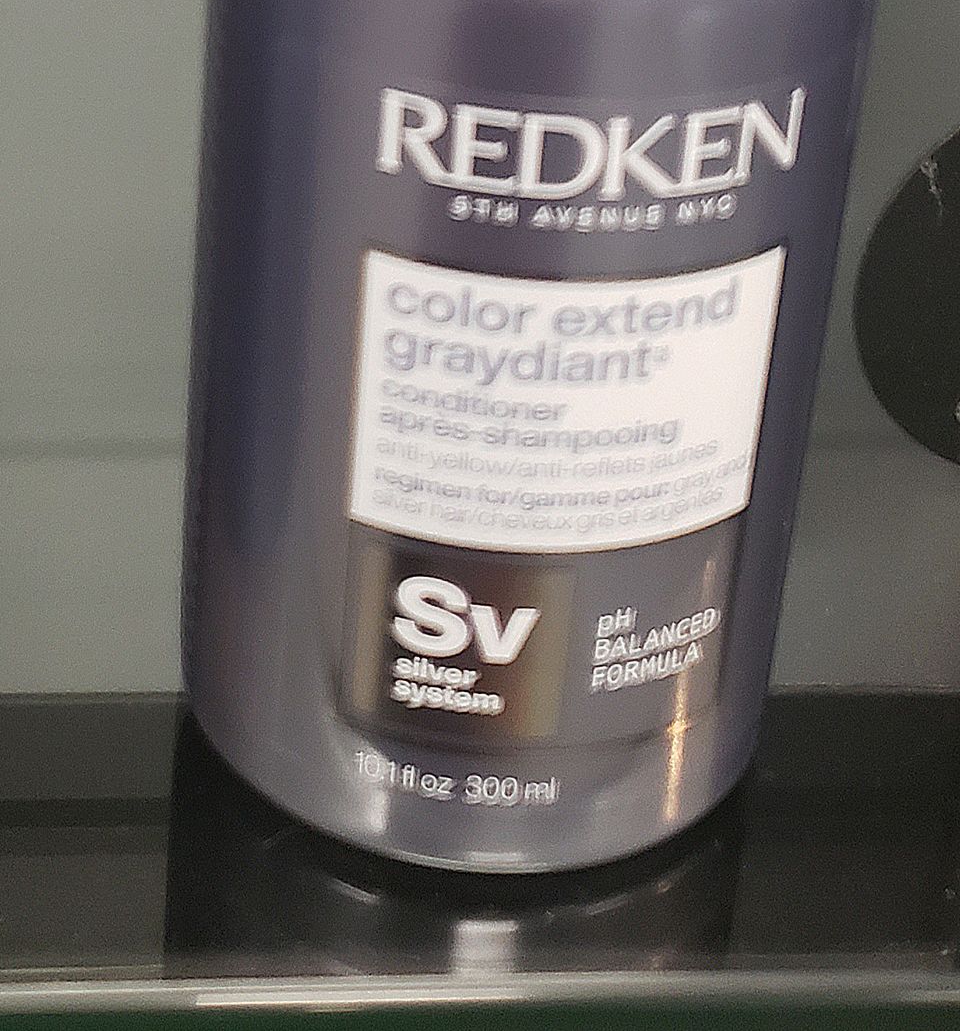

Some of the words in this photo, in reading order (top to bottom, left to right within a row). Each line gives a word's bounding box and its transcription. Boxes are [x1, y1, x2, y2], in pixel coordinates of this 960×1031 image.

[376, 86, 807, 201] REDKEN
[531, 204, 664, 232] AVENUE
[676, 193, 737, 220] NYC
[386, 280, 534, 333] color
[552, 277, 739, 336] extend
[381, 378, 569, 421] conditioner
[392, 576, 540, 665] Sv
[593, 607, 721, 664] BALANCED
[597, 607, 637, 639] pH
[393, 656, 481, 689] silver
[591, 643, 703, 693] FORMULA
[391, 678, 506, 716] system
[419, 774, 456, 800] oz
[462, 774, 518, 805] 300
[521, 776, 560, 804] ml
